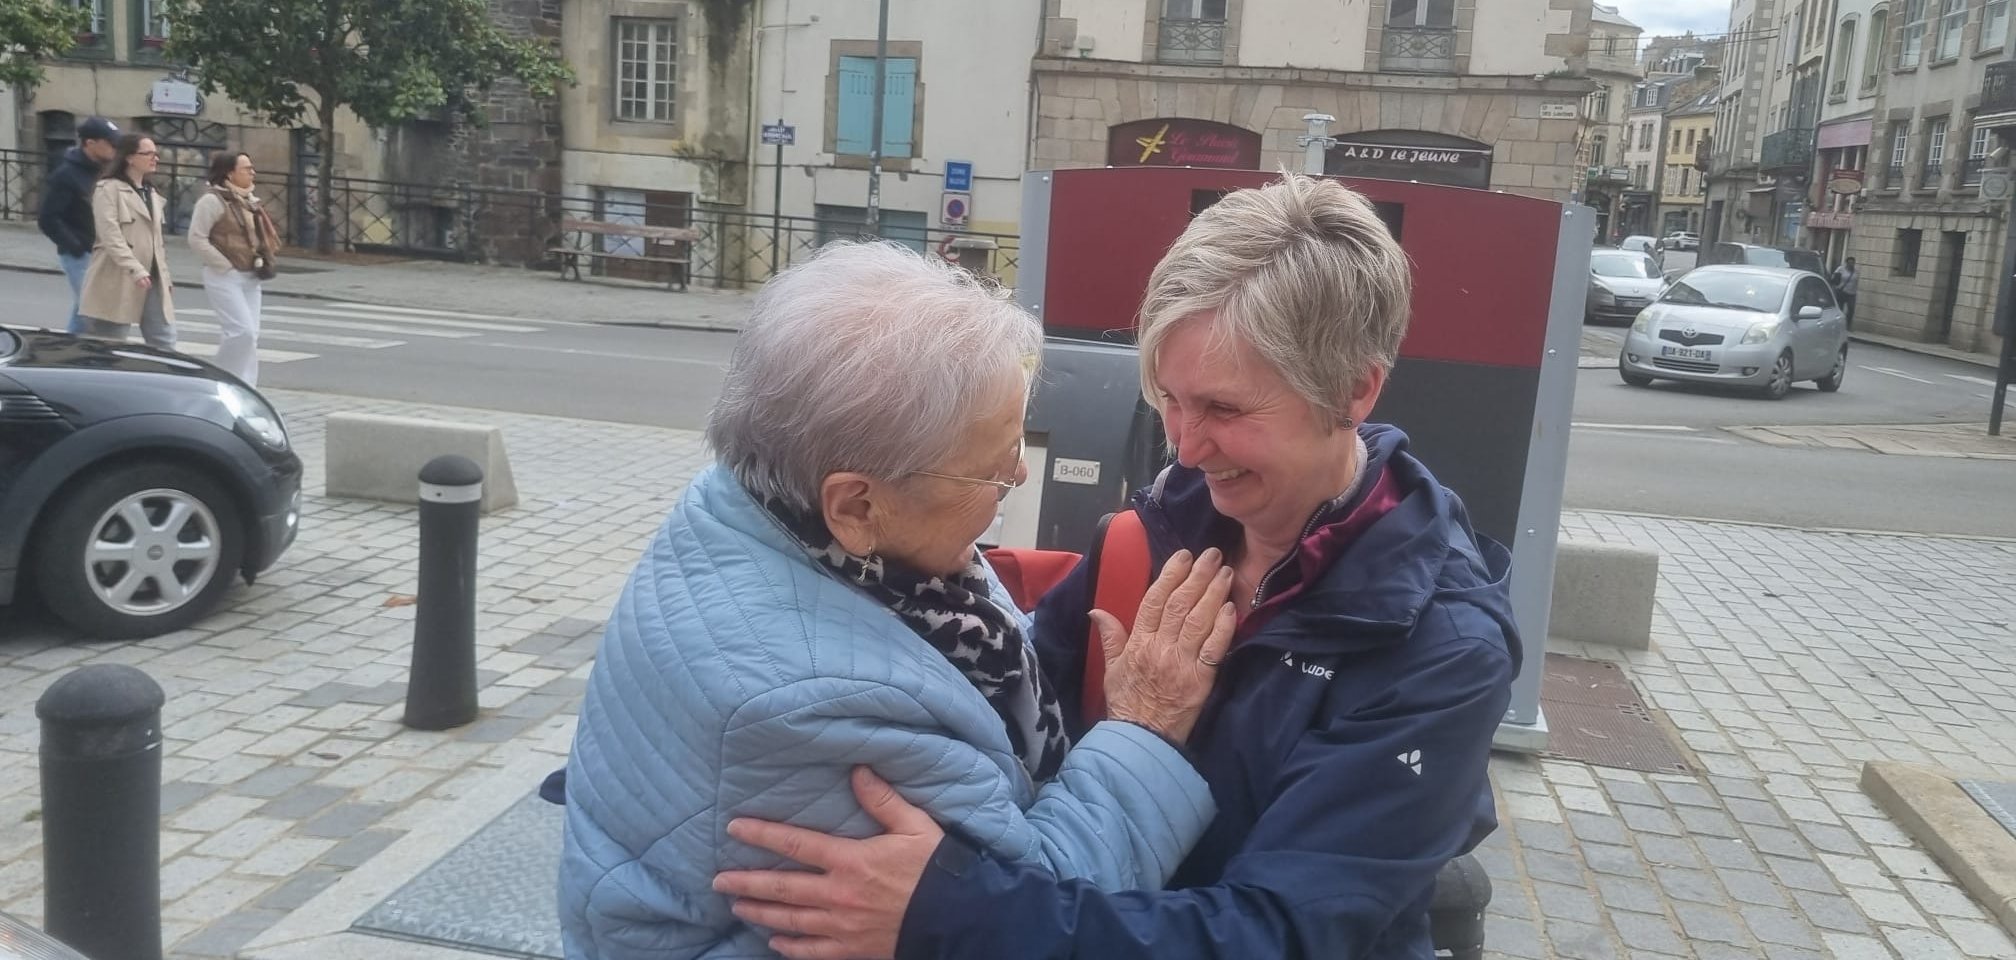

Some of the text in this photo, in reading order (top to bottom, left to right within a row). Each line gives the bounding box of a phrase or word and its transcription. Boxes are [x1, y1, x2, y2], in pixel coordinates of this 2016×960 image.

[1344, 147, 1356, 158] A
[1359, 148, 1369, 159] &
[1372, 148, 1384, 160] D
[1060, 465, 1095, 478] B-060
